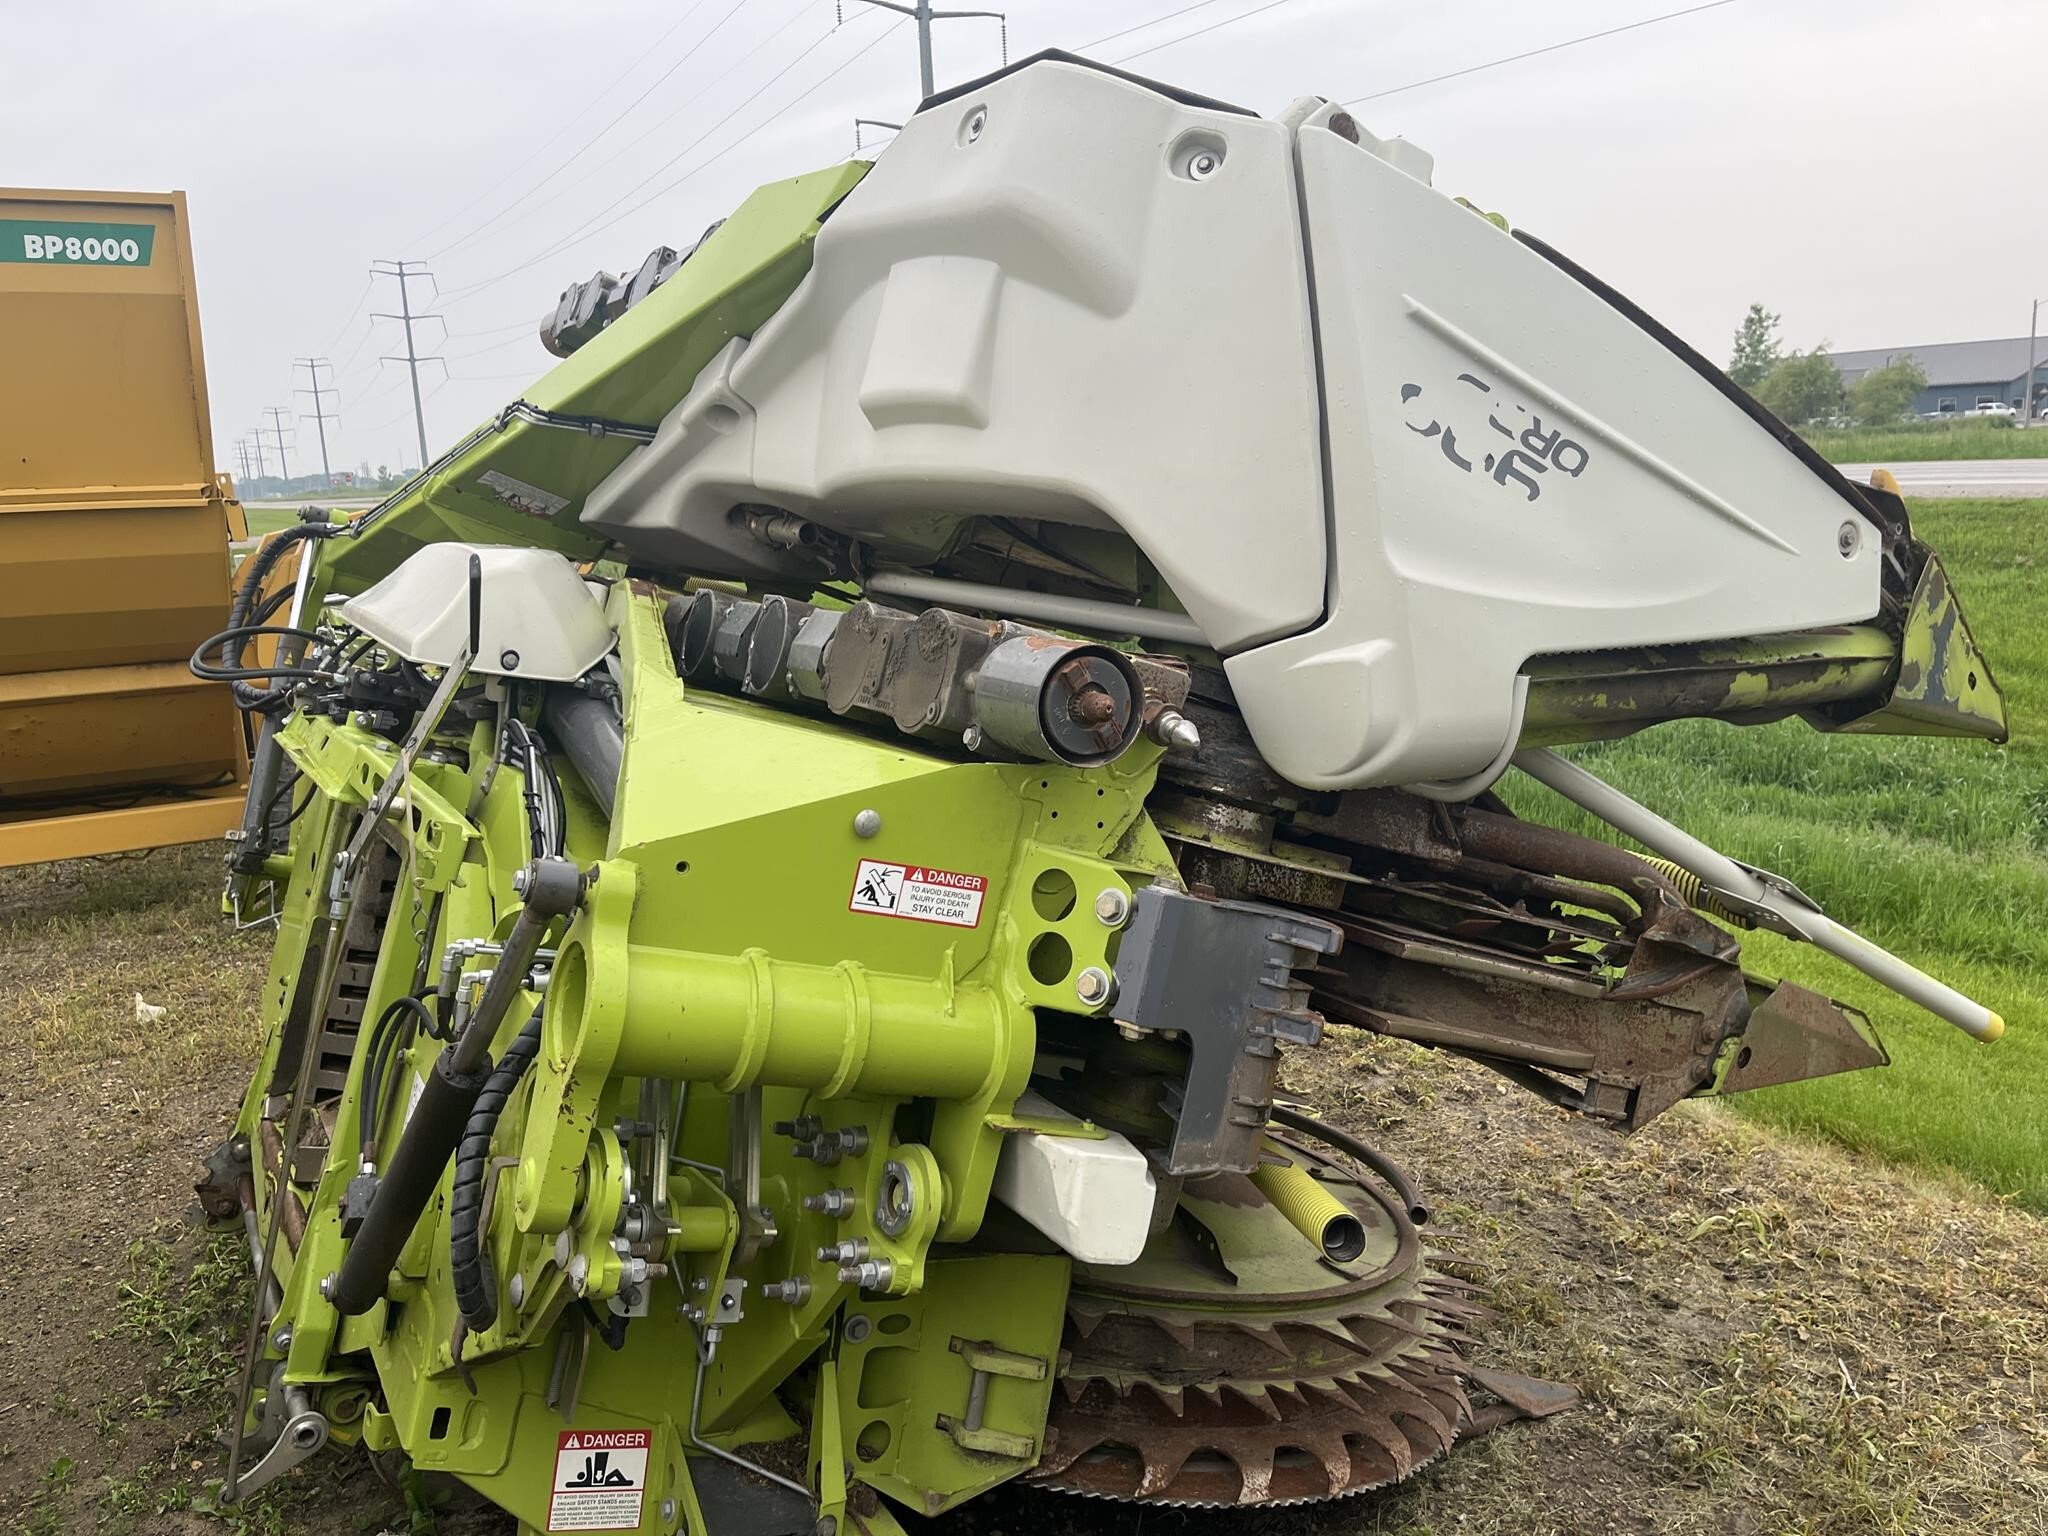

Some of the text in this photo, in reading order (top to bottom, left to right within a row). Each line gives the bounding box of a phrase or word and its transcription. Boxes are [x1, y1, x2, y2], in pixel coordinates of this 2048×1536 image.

[23, 234, 139, 262] BP8000
[927, 870, 982, 888] DANGER
[910, 893, 935, 903] INJURY
[946, 899, 969, 908] DEATH
[920, 886, 942, 895] AVOID
[942, 889, 971, 900] SERIOUS
[911, 903, 933, 914] STAY
[934, 906, 964, 918] CLEAR
[583, 1433, 645, 1447] DANGER
